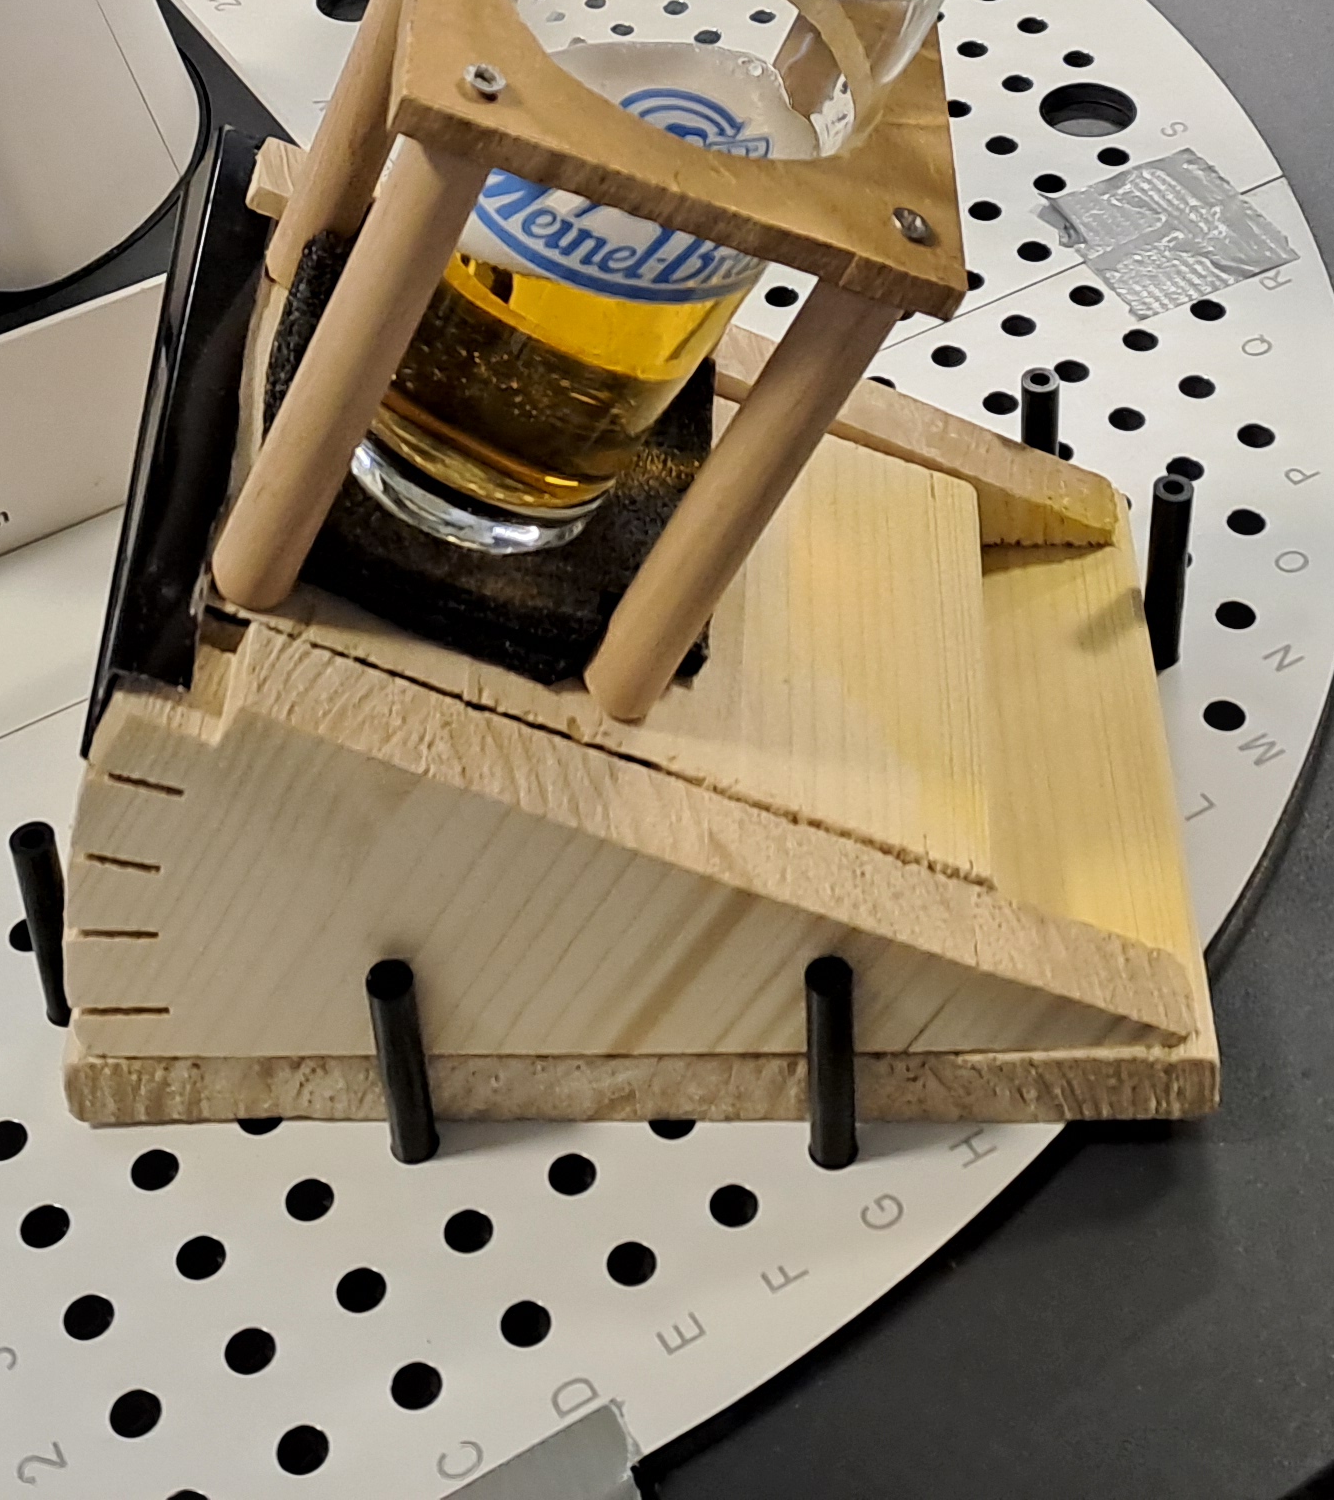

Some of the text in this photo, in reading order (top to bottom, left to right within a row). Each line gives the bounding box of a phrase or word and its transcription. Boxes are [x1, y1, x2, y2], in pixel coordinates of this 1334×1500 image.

[1159, 120, 1189, 139] S
[1258, 269, 1294, 292] R
[1240, 333, 1273, 358] Q
[1283, 466, 1321, 486] P
[1274, 549, 1310, 574] O
[1261, 642, 1305, 673] N
[1237, 732, 1287, 768] M
[1183, 792, 1218, 822] L
[948, 1127, 998, 1169] H
[860, 1191, 905, 1232] G
[761, 1262, 810, 1296] F
[655, 1310, 708, 1356] E
[551, 1376, 600, 1419] D
[16, 1440, 70, 1487] 2
[437, 1438, 486, 1482] C
